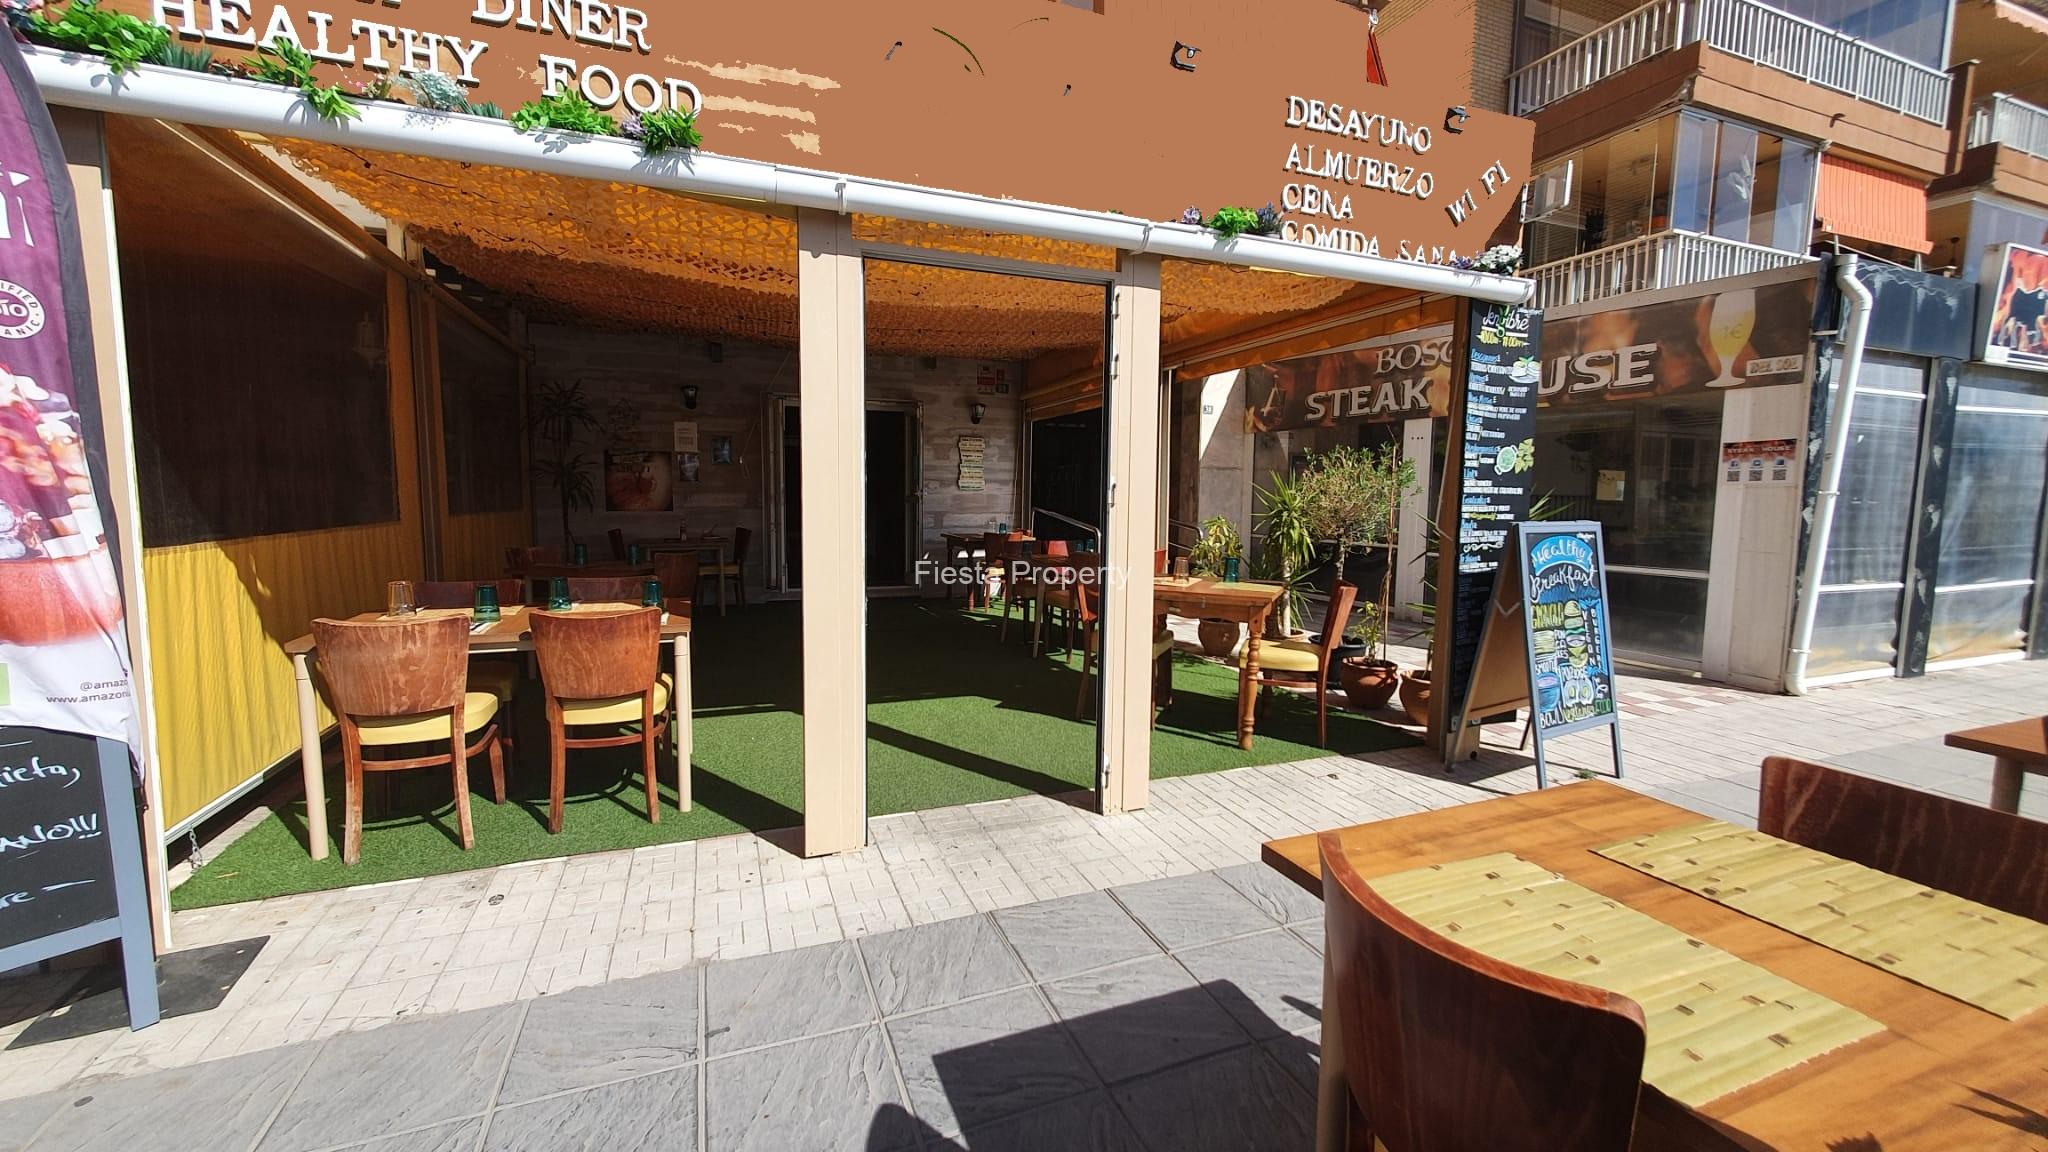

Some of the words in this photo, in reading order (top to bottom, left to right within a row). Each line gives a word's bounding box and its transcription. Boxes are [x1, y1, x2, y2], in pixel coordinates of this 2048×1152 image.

[472, 0, 652, 54] DINER
[152, 0, 489, 87] HEALTHY
[538, 53, 702, 121] FOOD
[1285, 95, 1432, 155] DESAYUNO
[1283, 142, 1435, 200] ALMUERZO
[1444, 188, 1478, 227] WI
[1481, 160, 1511, 198] FI
[1280, 183, 1354, 220] CENA
[1281, 221, 1381, 259] COMIDA
[1304, 376, 1434, 422] STEAK
[1536, 538, 1588, 564] Healthy
[1529, 564, 1599, 603] Breakfast
